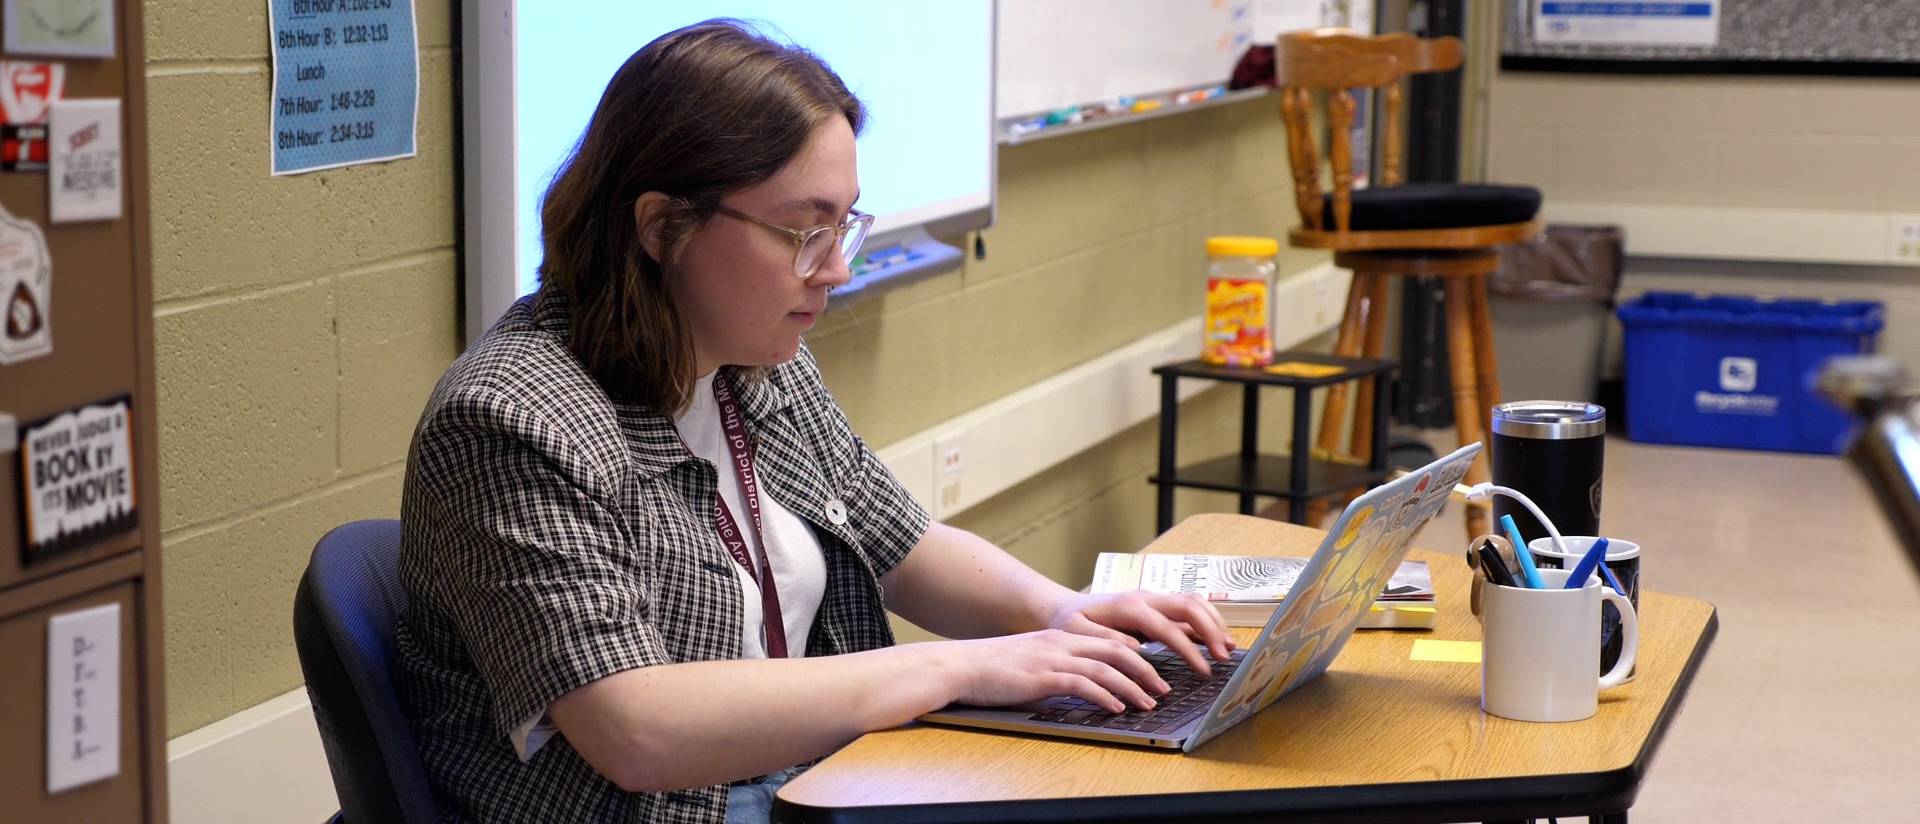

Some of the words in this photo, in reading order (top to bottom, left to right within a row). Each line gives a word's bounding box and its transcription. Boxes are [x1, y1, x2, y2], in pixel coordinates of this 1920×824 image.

[279, 30, 297, 48] 6th
[297, 28, 320, 47] Hour
[343, 23, 389, 44] 12:32-1:13
[297, 61, 325, 81] Lunch
[279, 97, 295, 116] 7th
[296, 96, 324, 113] Hour:
[331, 89, 375, 111] 1:48-2:29
[278, 130, 295, 150] 8th
[296, 130, 324, 147] Hour:
[330, 121, 375, 143] 2:34-3:15
[724, 403, 739, 430] the
[33, 430, 72, 453] NEVER
[77, 415, 112, 442] JUDGE
[730, 434, 745, 449] of
[35, 443, 91, 489] BOOK
[96, 443, 113, 469] BY
[736, 451, 758, 509] District
[66, 467, 127, 514] MOVIE
